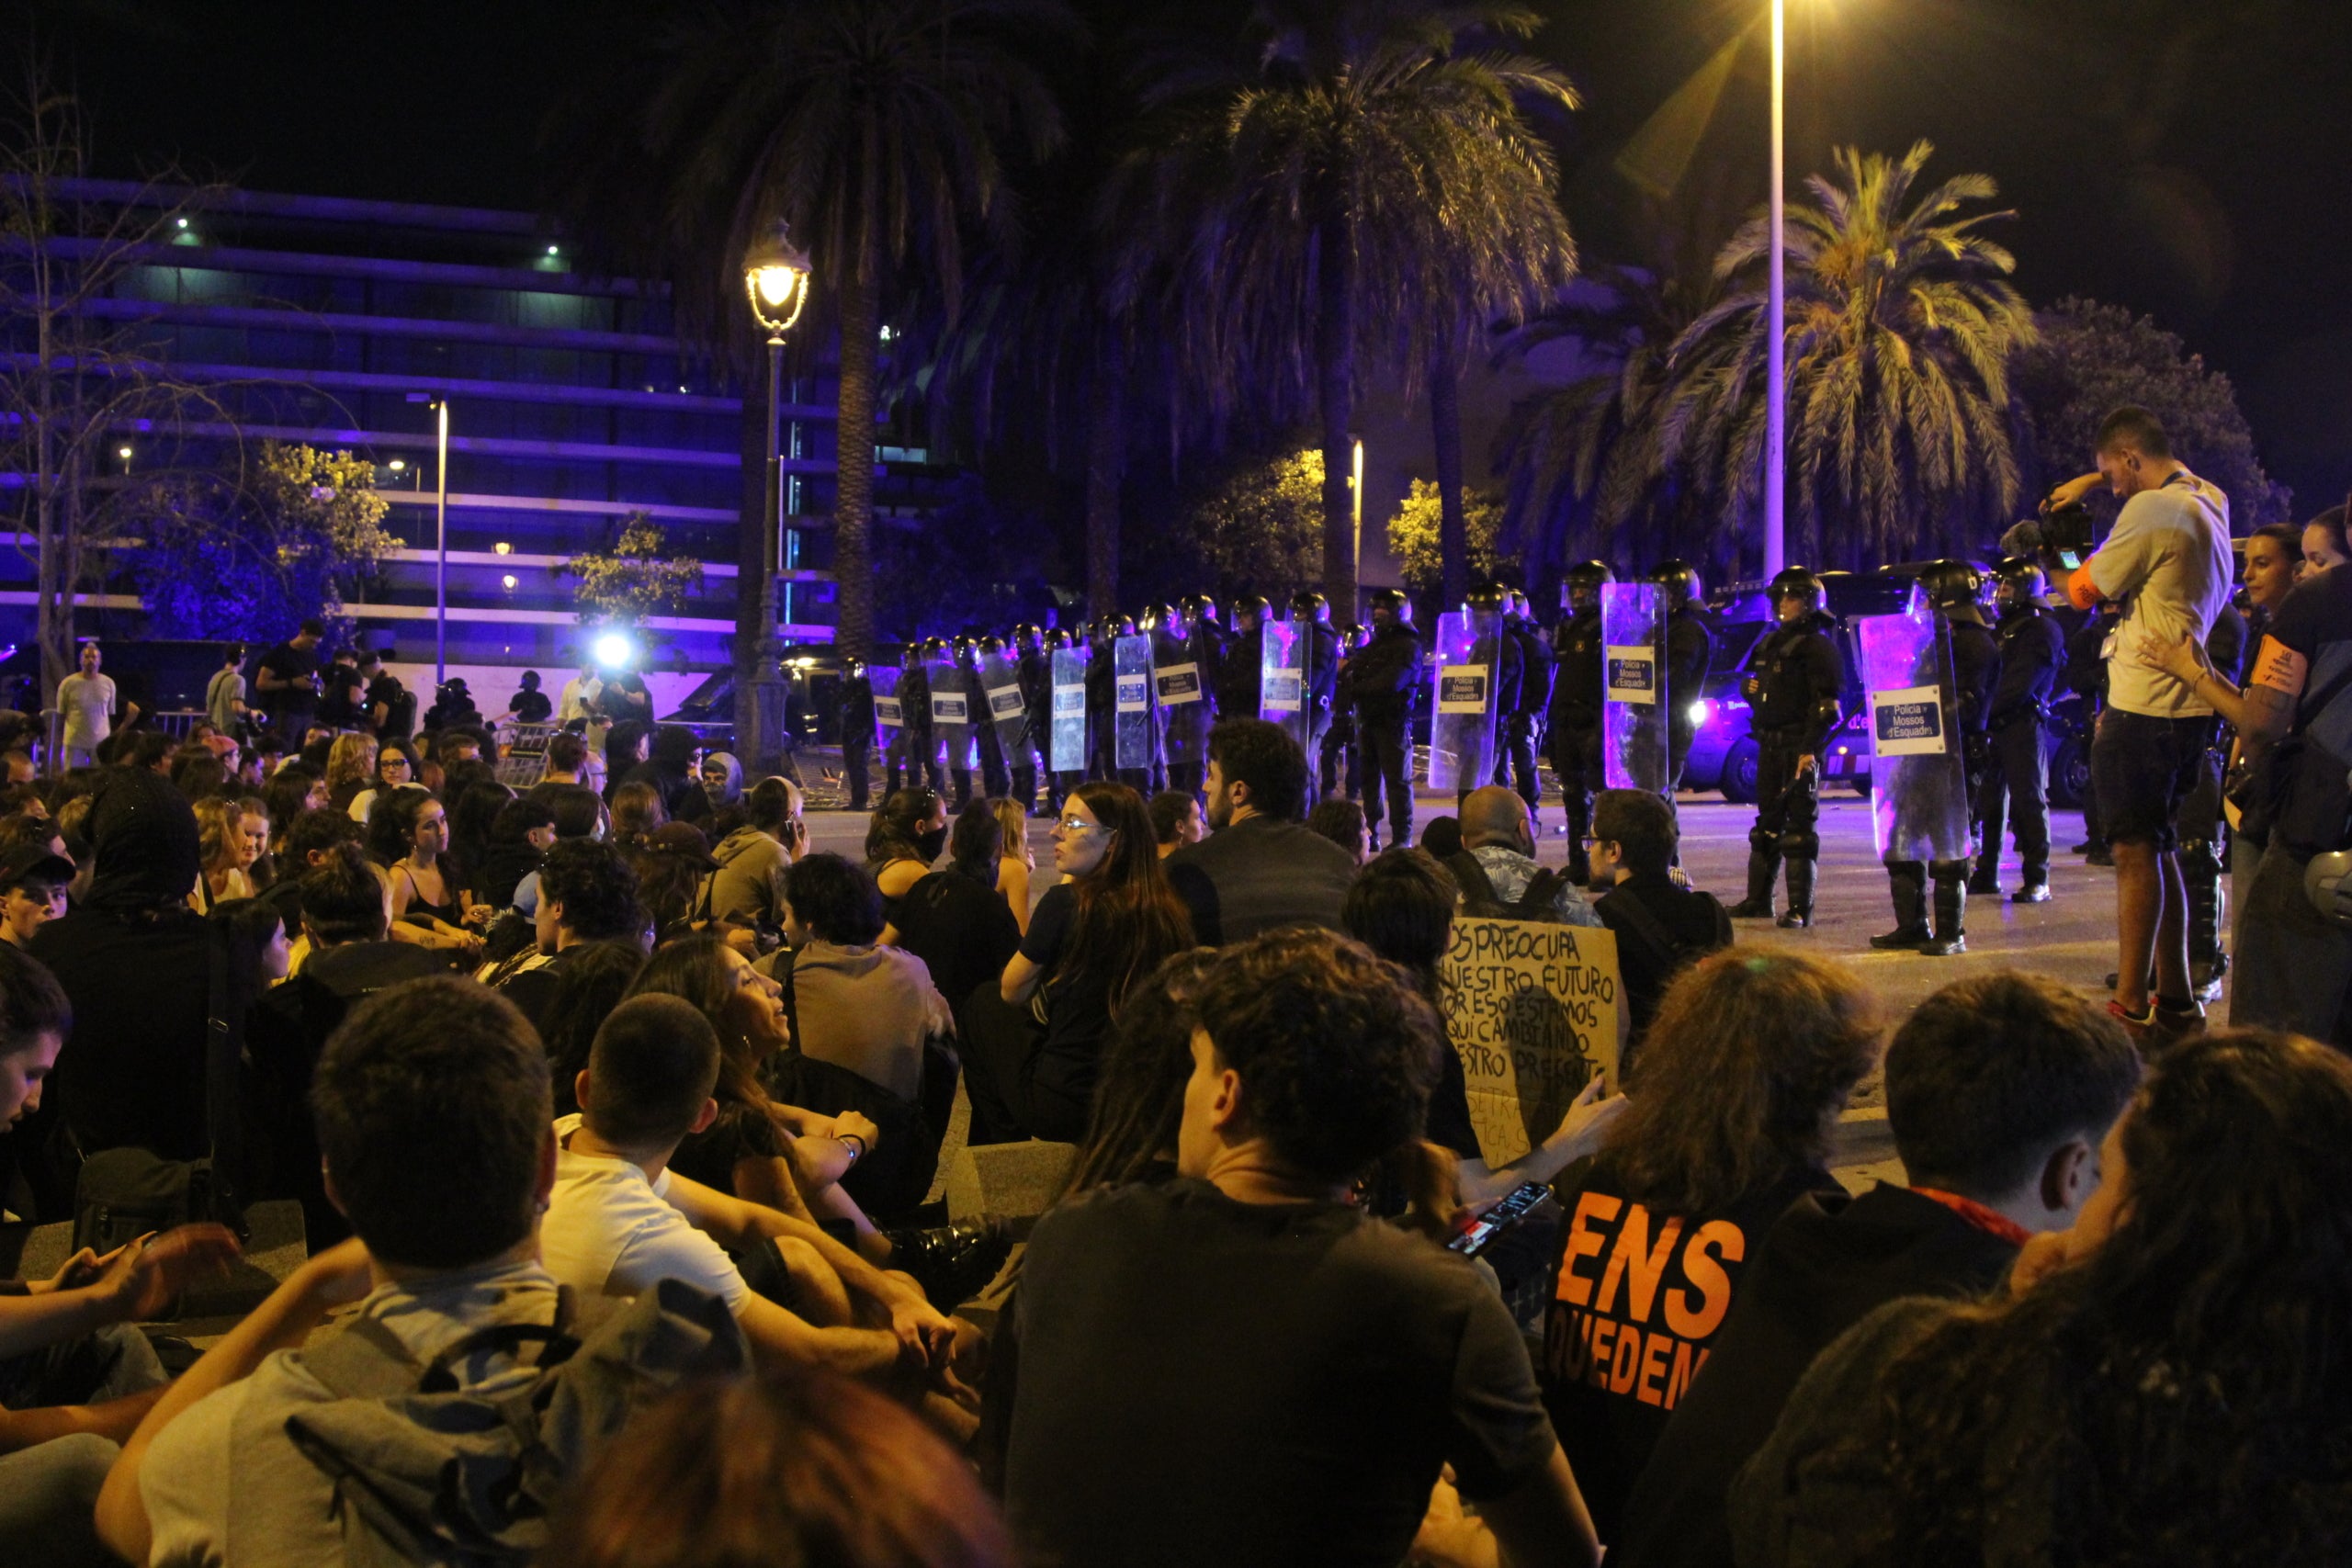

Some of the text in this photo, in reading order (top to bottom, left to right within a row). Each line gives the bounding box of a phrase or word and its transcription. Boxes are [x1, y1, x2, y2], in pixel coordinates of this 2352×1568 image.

[1894, 705, 1922, 715] Policia
[1894, 716, 1925, 726] Mossos
[1450, 923, 1580, 962] OS PREOCUPA
[1543, 965, 1613, 1003] FUTURO
[1444, 988, 1598, 1027] OR ESO ESTAMOS
[1477, 1018, 1590, 1053] CAMBIANDO
[1457, 1043, 1506, 1077] ESTRO
[1555, 1191, 1745, 1339] ENS
